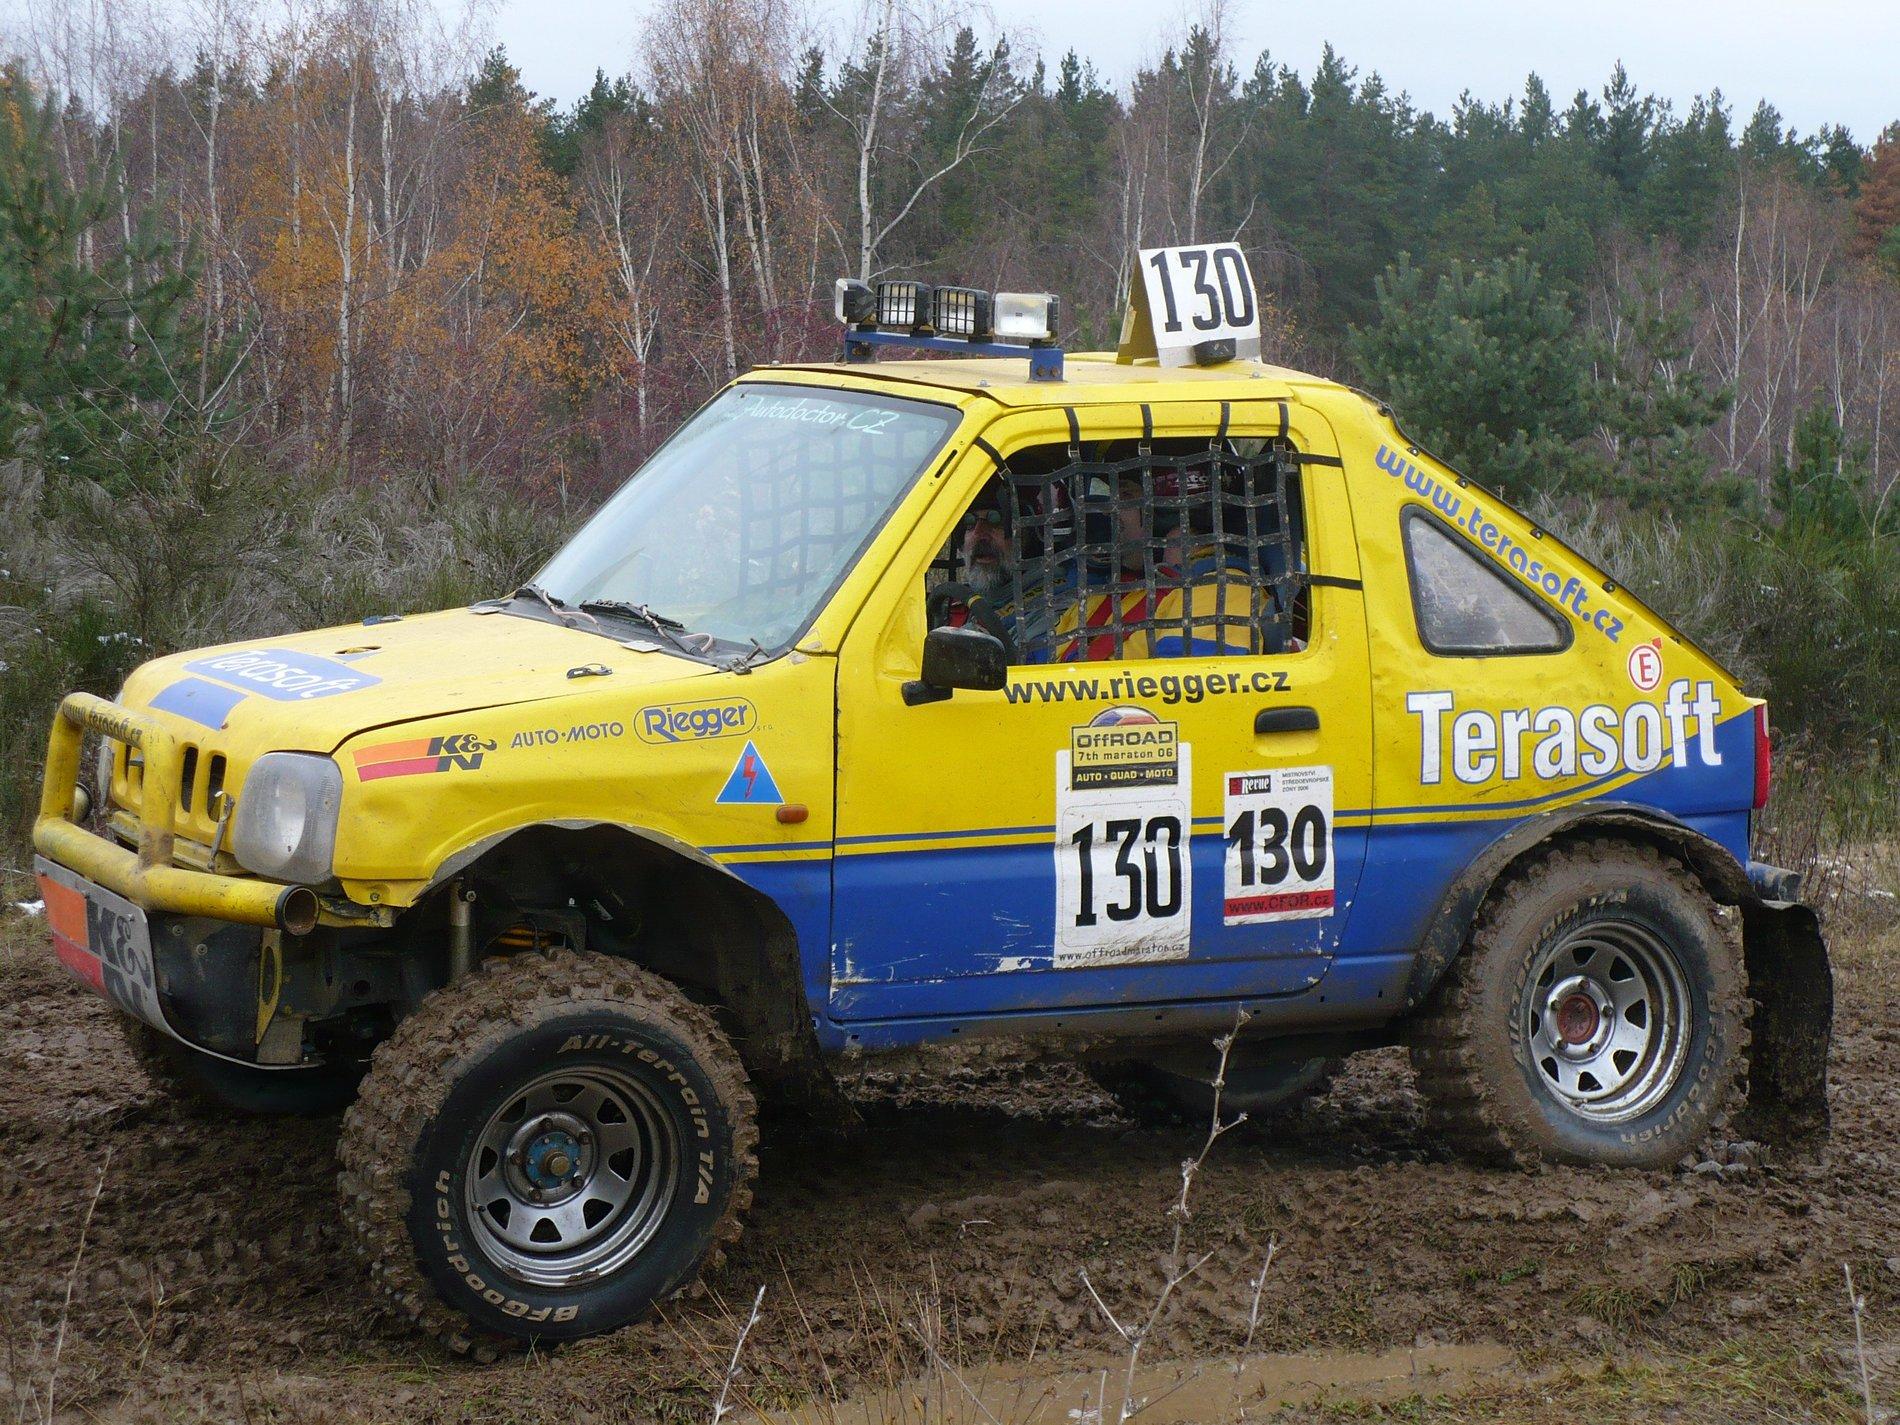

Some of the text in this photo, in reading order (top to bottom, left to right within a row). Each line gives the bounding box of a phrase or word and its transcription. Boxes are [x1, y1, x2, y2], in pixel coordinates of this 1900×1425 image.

[1150, 248, 1255, 333] 130
[1375, 444, 1626, 644] www.terasoft.cz
[200, 650, 361, 699] Terasoft
[1003, 670, 1292, 705] www.riegger.cz
[1639, 653, 1653, 683] E
[643, 704, 748, 742] Riegger
[1077, 731, 1173, 748] OffROAD
[1406, 678, 1723, 786] Terasoft
[427, 733, 498, 772] K&N
[1076, 768, 1174, 782] AUTO QUAD MOTO
[1079, 747, 1173, 761] 7th maraton 06
[1228, 804, 1328, 887] 130
[1072, 815, 1182, 927] 130
[557, 1034, 714, 1204] All-Terrain T/A
[436, 1170, 580, 1323] BFGoodrich
